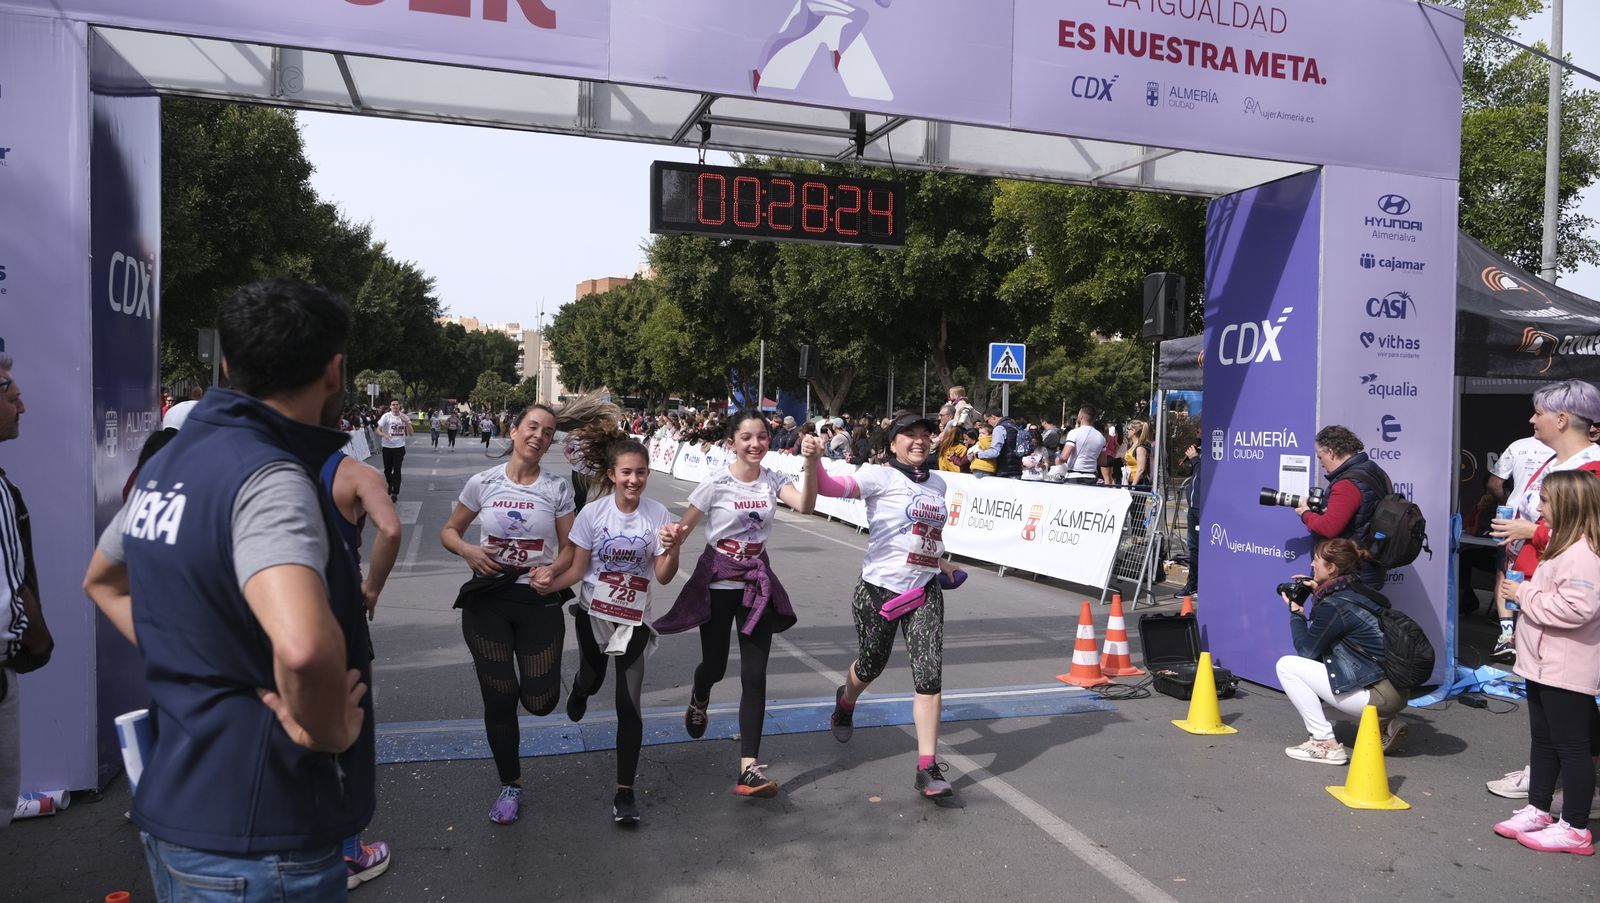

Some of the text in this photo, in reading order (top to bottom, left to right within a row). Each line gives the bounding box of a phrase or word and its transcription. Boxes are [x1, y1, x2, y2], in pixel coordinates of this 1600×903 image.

[1058, 19, 1328, 86] ES NUESTRA META.
[1169, 85, 1219, 105] ALMERÍA
[1168, 99, 1195, 111] CIUDAD
[698, 172, 894, 237] 00:28:24
[1364, 216, 1422, 232] HYUNDAI
[1371, 230, 1417, 243] Almerialva
[1378, 256, 1426, 271] cajamar
[1366, 297, 1407, 319] CASI
[1378, 334, 1421, 350] vithas
[1368, 381, 1418, 400] aqualia
[1234, 427, 1298, 448] ALMERÍA
[1233, 449, 1265, 460] CIUDAD
[1369, 447, 1402, 460] Clece
[492, 501, 535, 510] MUJER
[734, 501, 768, 510] MUJER
[921, 503, 940, 513] MINI
[971, 497, 1023, 522] ALMERÍA
[912, 509, 946, 522] RUNNER
[967, 516, 994, 531] CIUDAD
[1050, 508, 1116, 534] ALMERÍA
[1048, 529, 1080, 546] CIUDAD
[499, 544, 529, 563] 729
[612, 548, 637, 556] MINI
[608, 584, 637, 603] 728
